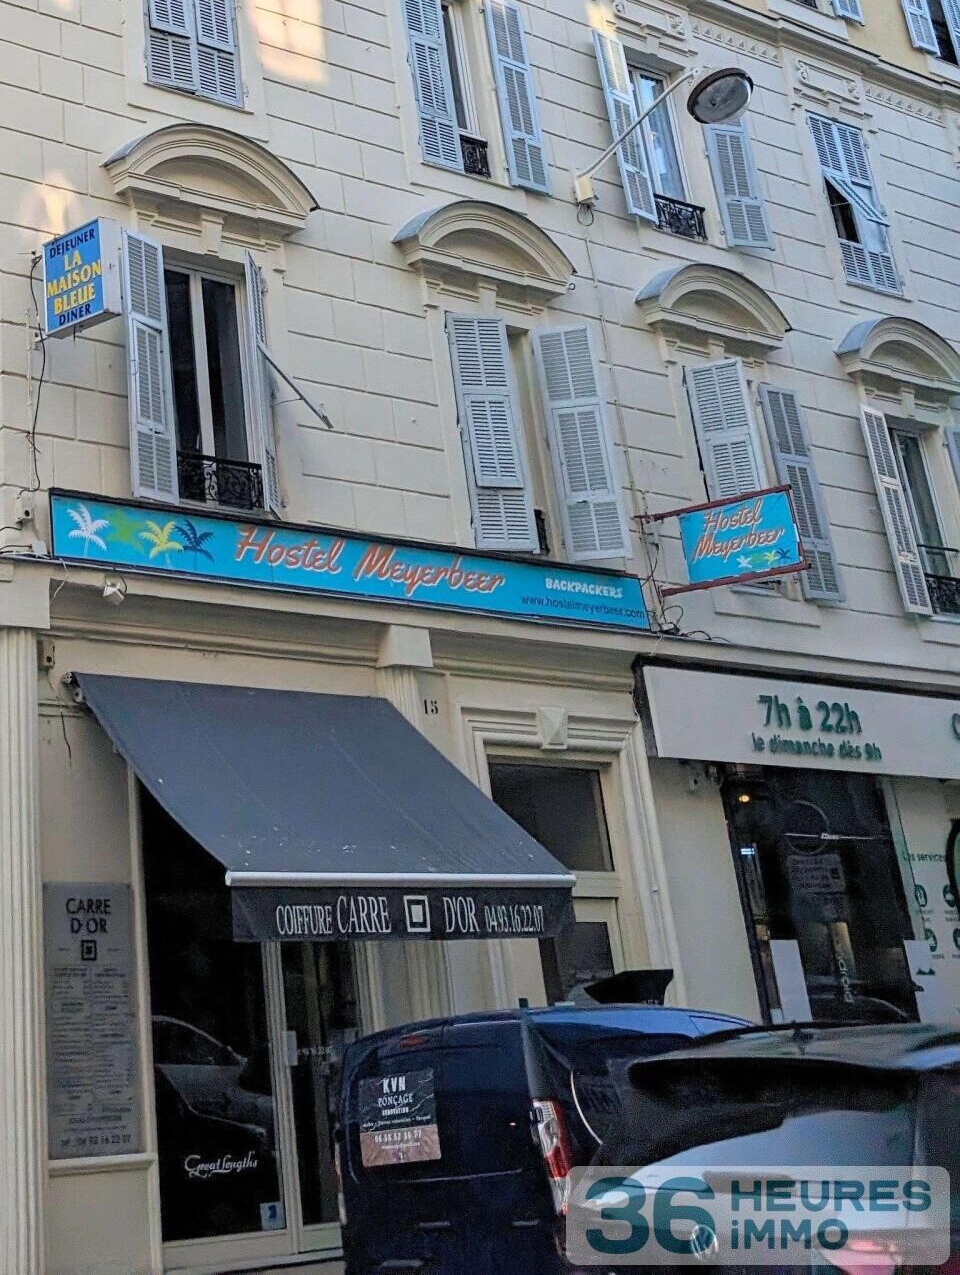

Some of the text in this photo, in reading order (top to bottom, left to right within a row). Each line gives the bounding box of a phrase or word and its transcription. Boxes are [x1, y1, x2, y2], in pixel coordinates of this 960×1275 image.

[64, 250, 82, 272] LA
[47, 260, 101, 299] MAISON
[53, 284, 96, 316] BLEUE
[59, 303, 92, 326] DINER
[704, 498, 764, 536] Hostel
[691, 525, 786, 564] Meyerbeer
[235, 524, 506, 597] Hostel Meyerbeer
[544, 578, 624, 599] BACKPACKERS
[520, 595, 646, 619] www.hostelmeyerbeer.com
[758, 694, 863, 735] 7h à 22h
[751, 731, 883, 761] le dimanche dès 9h
[66, 897, 112, 915] CARRE
[276, 905, 333, 935] COIFFURE
[336, 895, 392, 933] CARRE
[442, 896, 481, 933] D'OR
[382, 1076, 406, 1094] KVN
[184, 1154, 222, 1179] Great
